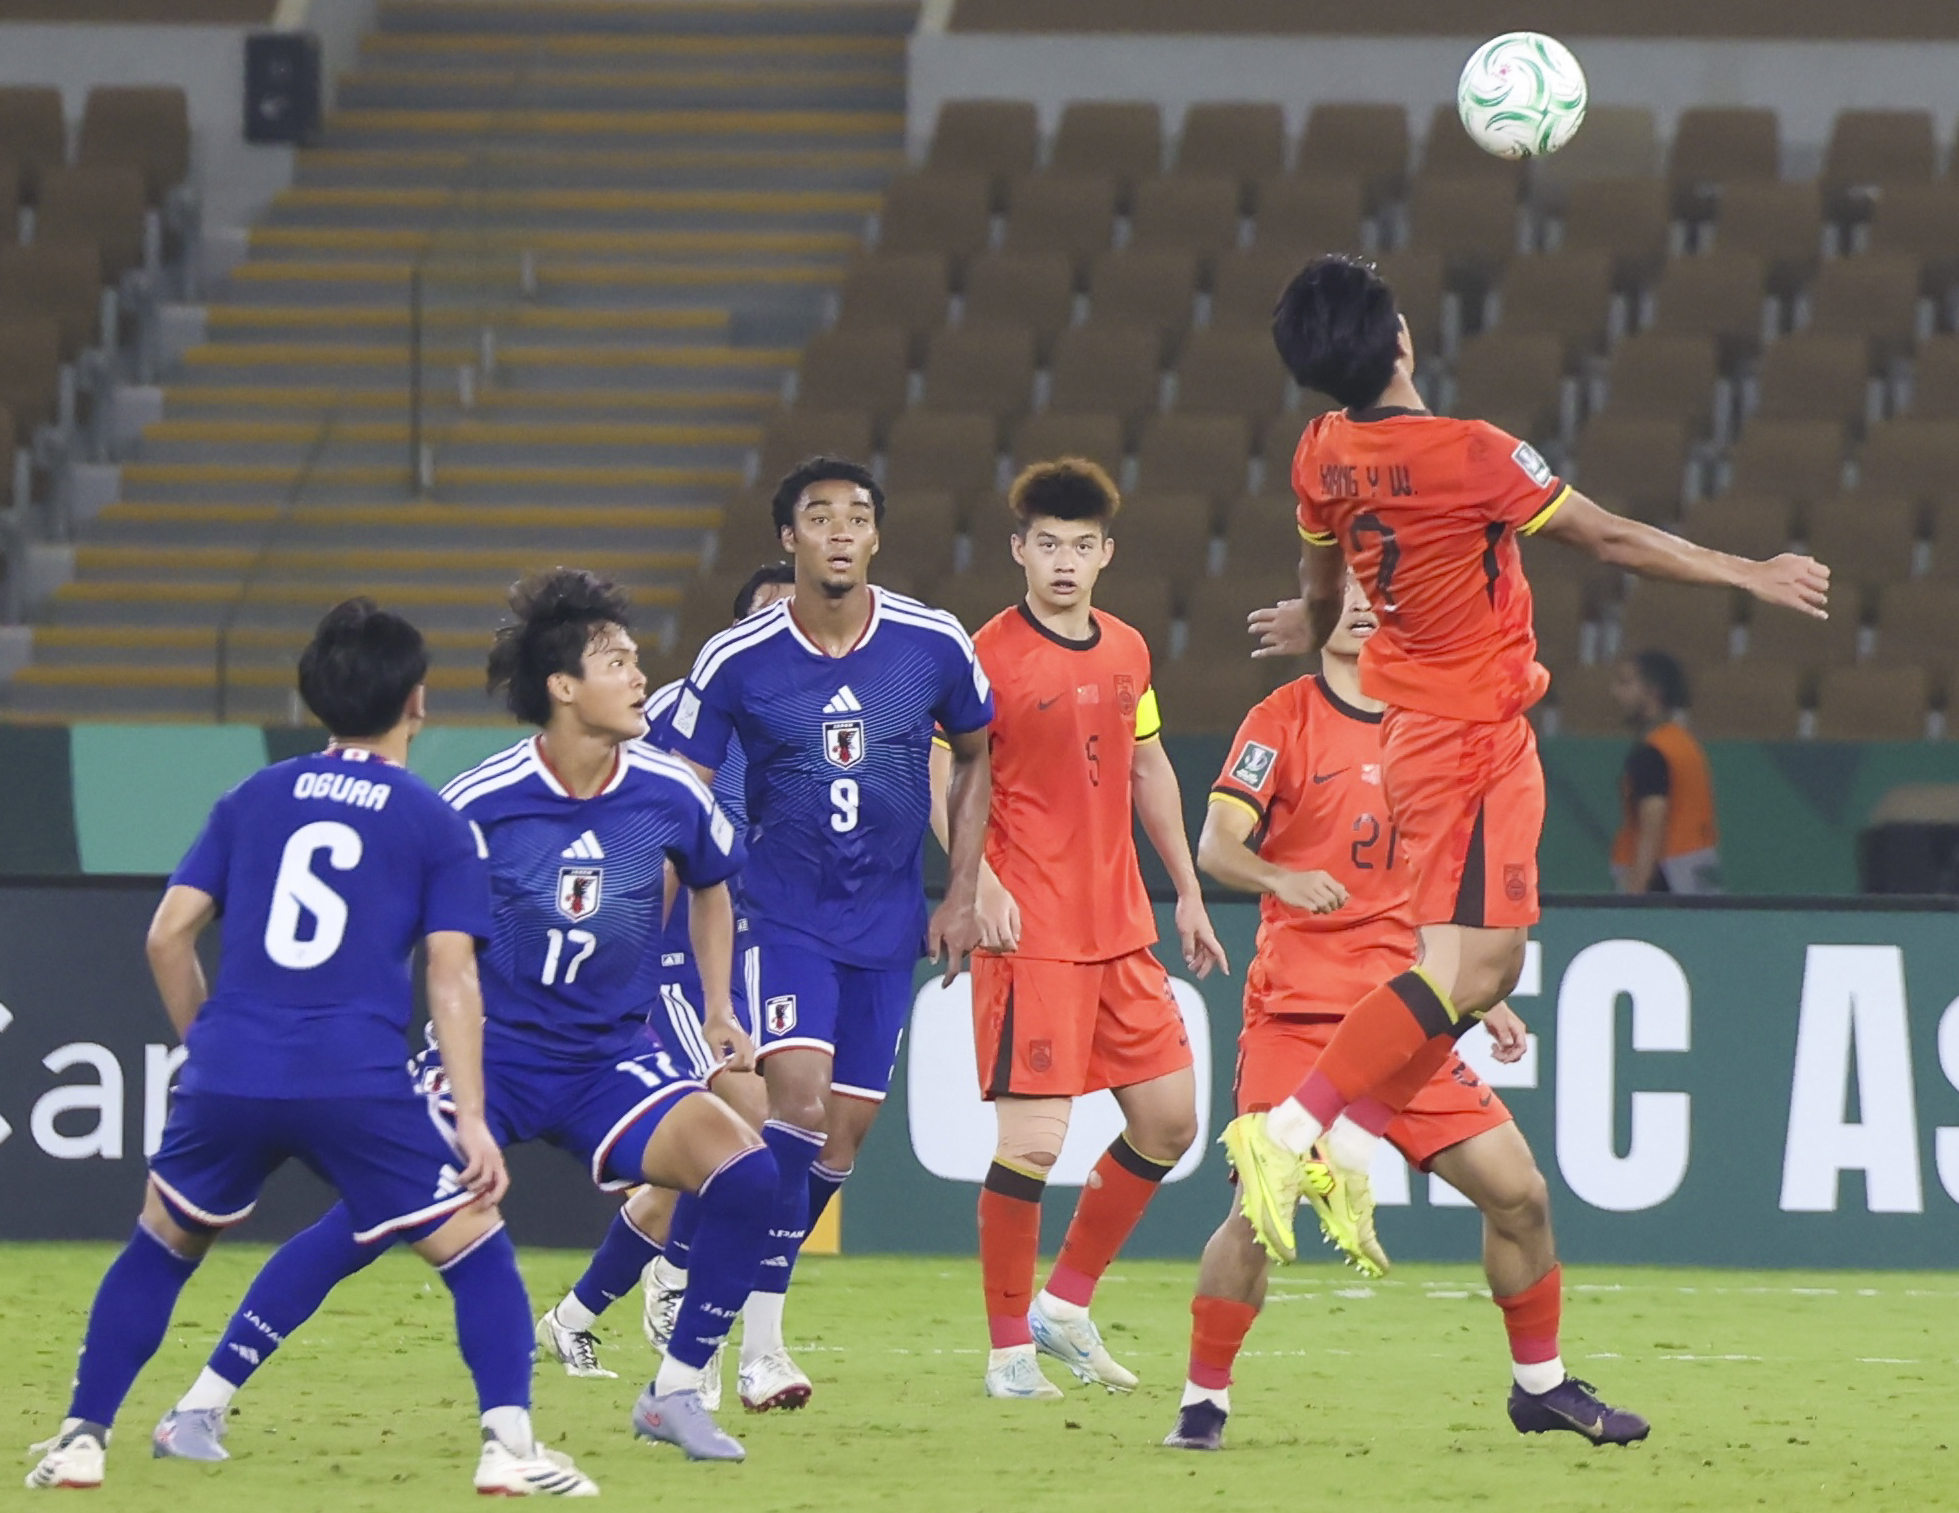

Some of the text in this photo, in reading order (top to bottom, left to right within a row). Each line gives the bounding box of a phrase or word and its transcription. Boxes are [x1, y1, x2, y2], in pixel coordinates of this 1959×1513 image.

[1366, 465, 1379, 498] Y
[293, 772, 391, 812] OGURA
[830, 778, 859, 832] 9
[1352, 813, 1396, 870] 21
[264, 821, 363, 970] 6
[541, 928, 596, 986] 17
[615, 1050, 680, 1088] 17
